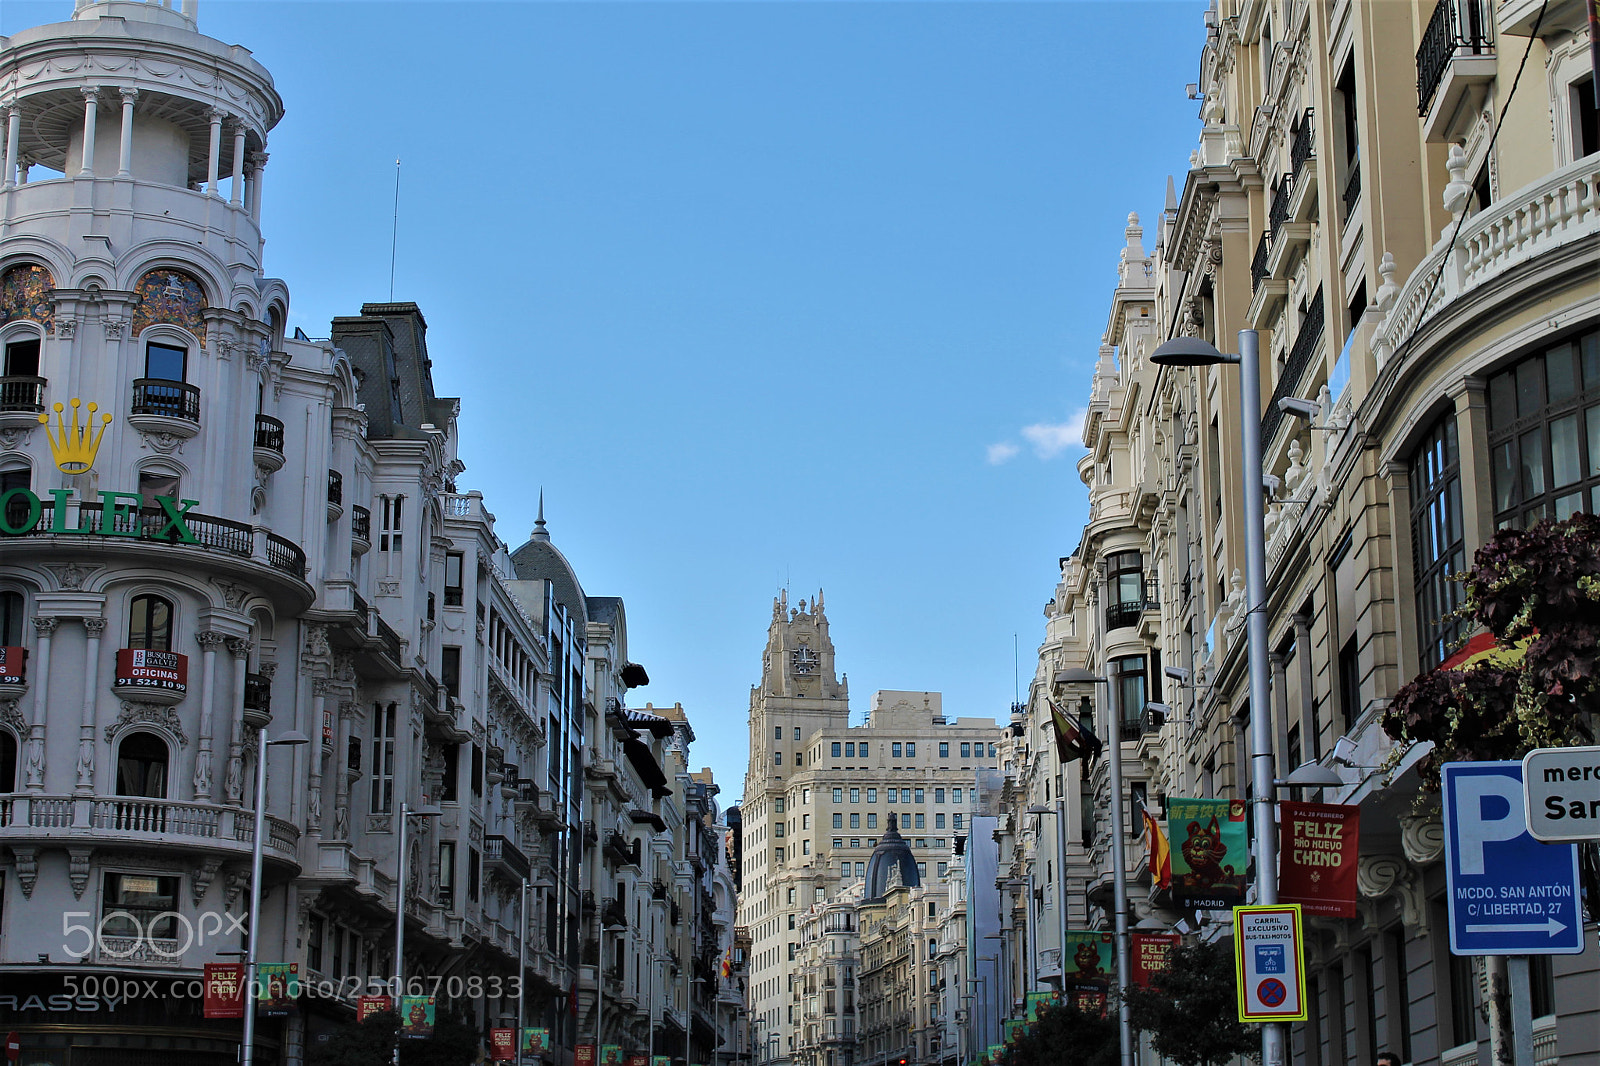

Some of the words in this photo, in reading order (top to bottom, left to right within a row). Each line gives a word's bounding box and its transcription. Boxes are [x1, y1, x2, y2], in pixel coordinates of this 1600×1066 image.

[146, 657, 177, 667] GALVEZ
[147, 651, 178, 660] BUSQUETS
[132, 669, 178, 680] OFICINAS
[118, 678, 132, 686] 91
[136, 678, 158, 686] 524
[162, 680, 174, 688] 10
[176, 683, 186, 691] 99
[1170, 804, 1230, 820] 新春快乐
[1293, 821, 1343, 839] FELIZ
[1454, 774, 1527, 875] P
[1294, 837, 1310, 848] AÑO
[1312, 840, 1342, 851] NUEVO
[1293, 850, 1342, 867] CHINO
[1457, 887, 1497, 900] MCDO.
[1500, 886, 1525, 899] SAN
[1529, 882, 1571, 898] ANTÓN
[1193, 899, 1225, 907] MADRID
[1468, 904, 1481, 916] C/
[1484, 902, 1546, 916] LIBERTAD,
[1549, 902, 1562, 914] 27
[211, 972, 237, 980] FELIZ
[0, 994, 124, 1012] RASSY
